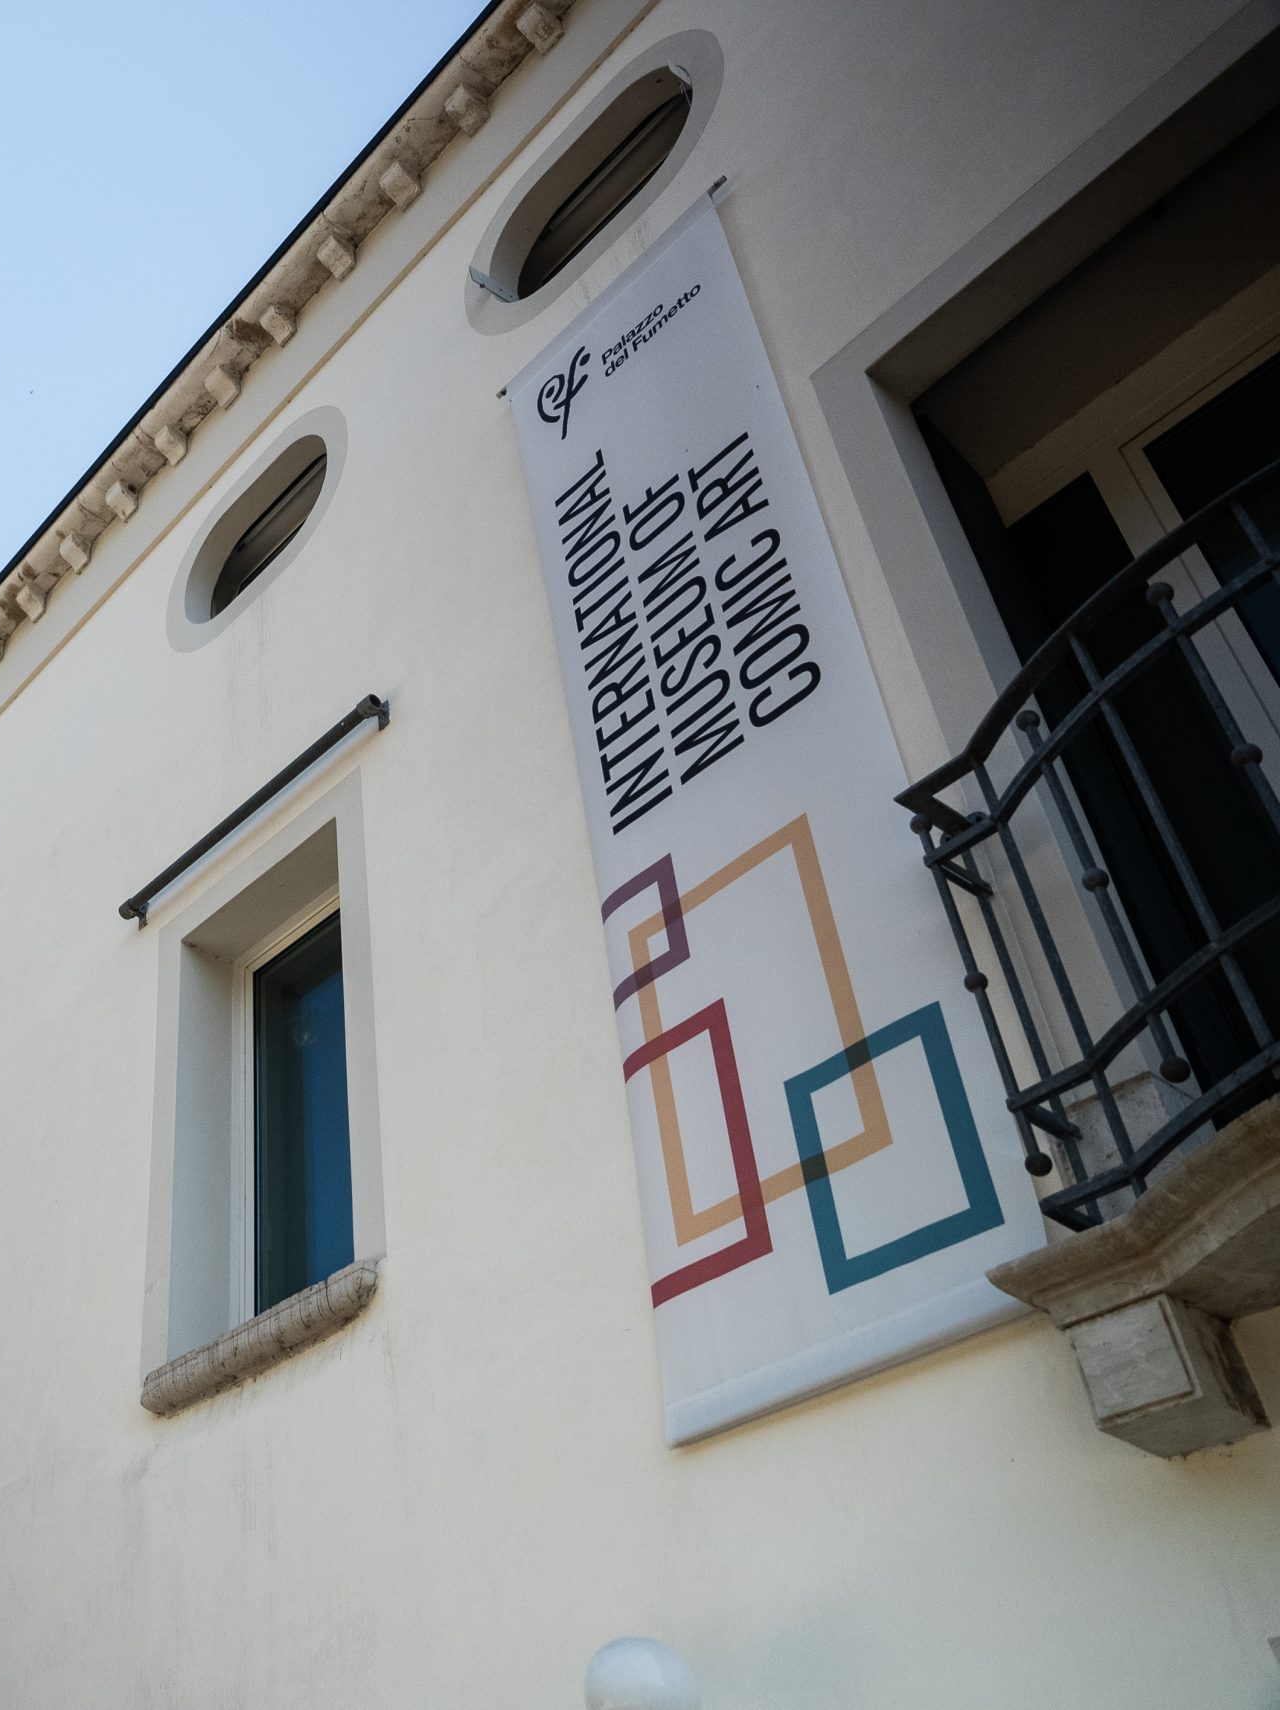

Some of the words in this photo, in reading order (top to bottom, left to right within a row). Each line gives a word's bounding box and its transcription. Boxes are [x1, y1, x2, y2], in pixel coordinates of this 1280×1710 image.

[601, 304, 664, 365] Palazzo
[605, 349, 629, 377] del
[632, 284, 701, 352] Fumetto
[622, 473, 686, 551] OF
[687, 431, 769, 542] ART
[555, 448, 673, 836] INTERNATIONAL
[638, 530, 745, 786] MUSEUM
[714, 528, 821, 728] COMIC
